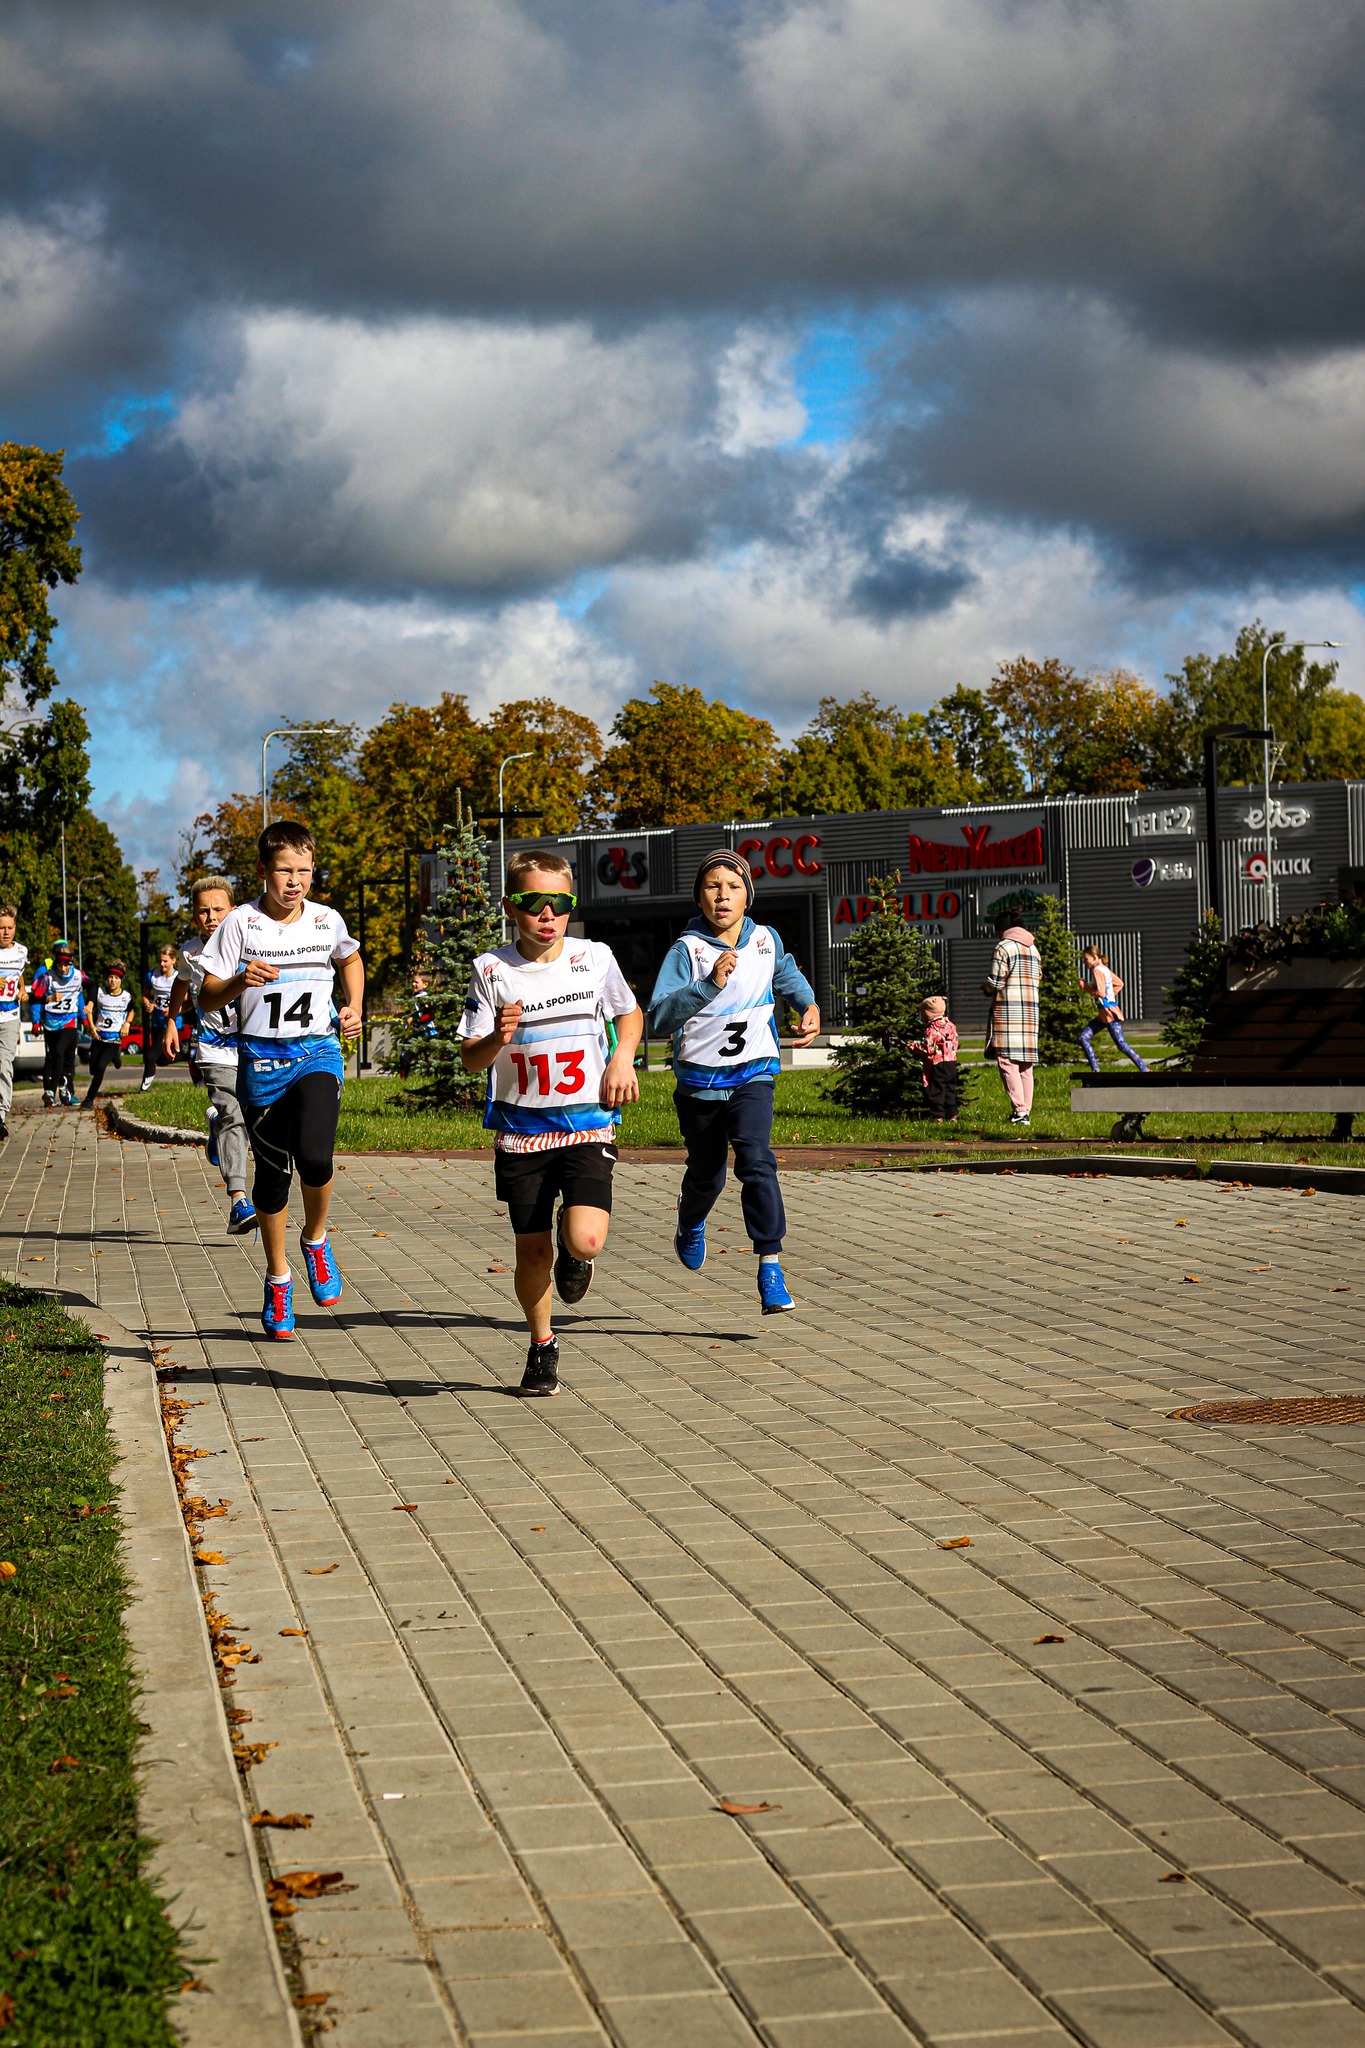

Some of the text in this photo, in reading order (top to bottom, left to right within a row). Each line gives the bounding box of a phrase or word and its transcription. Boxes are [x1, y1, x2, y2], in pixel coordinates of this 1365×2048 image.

[1130, 806, 1194, 836] TELE2
[737, 834, 820, 879] CCC
[1273, 857, 1312, 876] KLICK
[245, 947, 296, 958] IDA-VIRUMAA
[570, 965, 590, 973] IVSL
[52, 998, 72, 1011] 23
[263, 992, 314, 1029] 14
[546, 990, 595, 1008] SPORDILIIT
[718, 1021, 748, 1058] 3
[510, 1049, 586, 1096] 113
